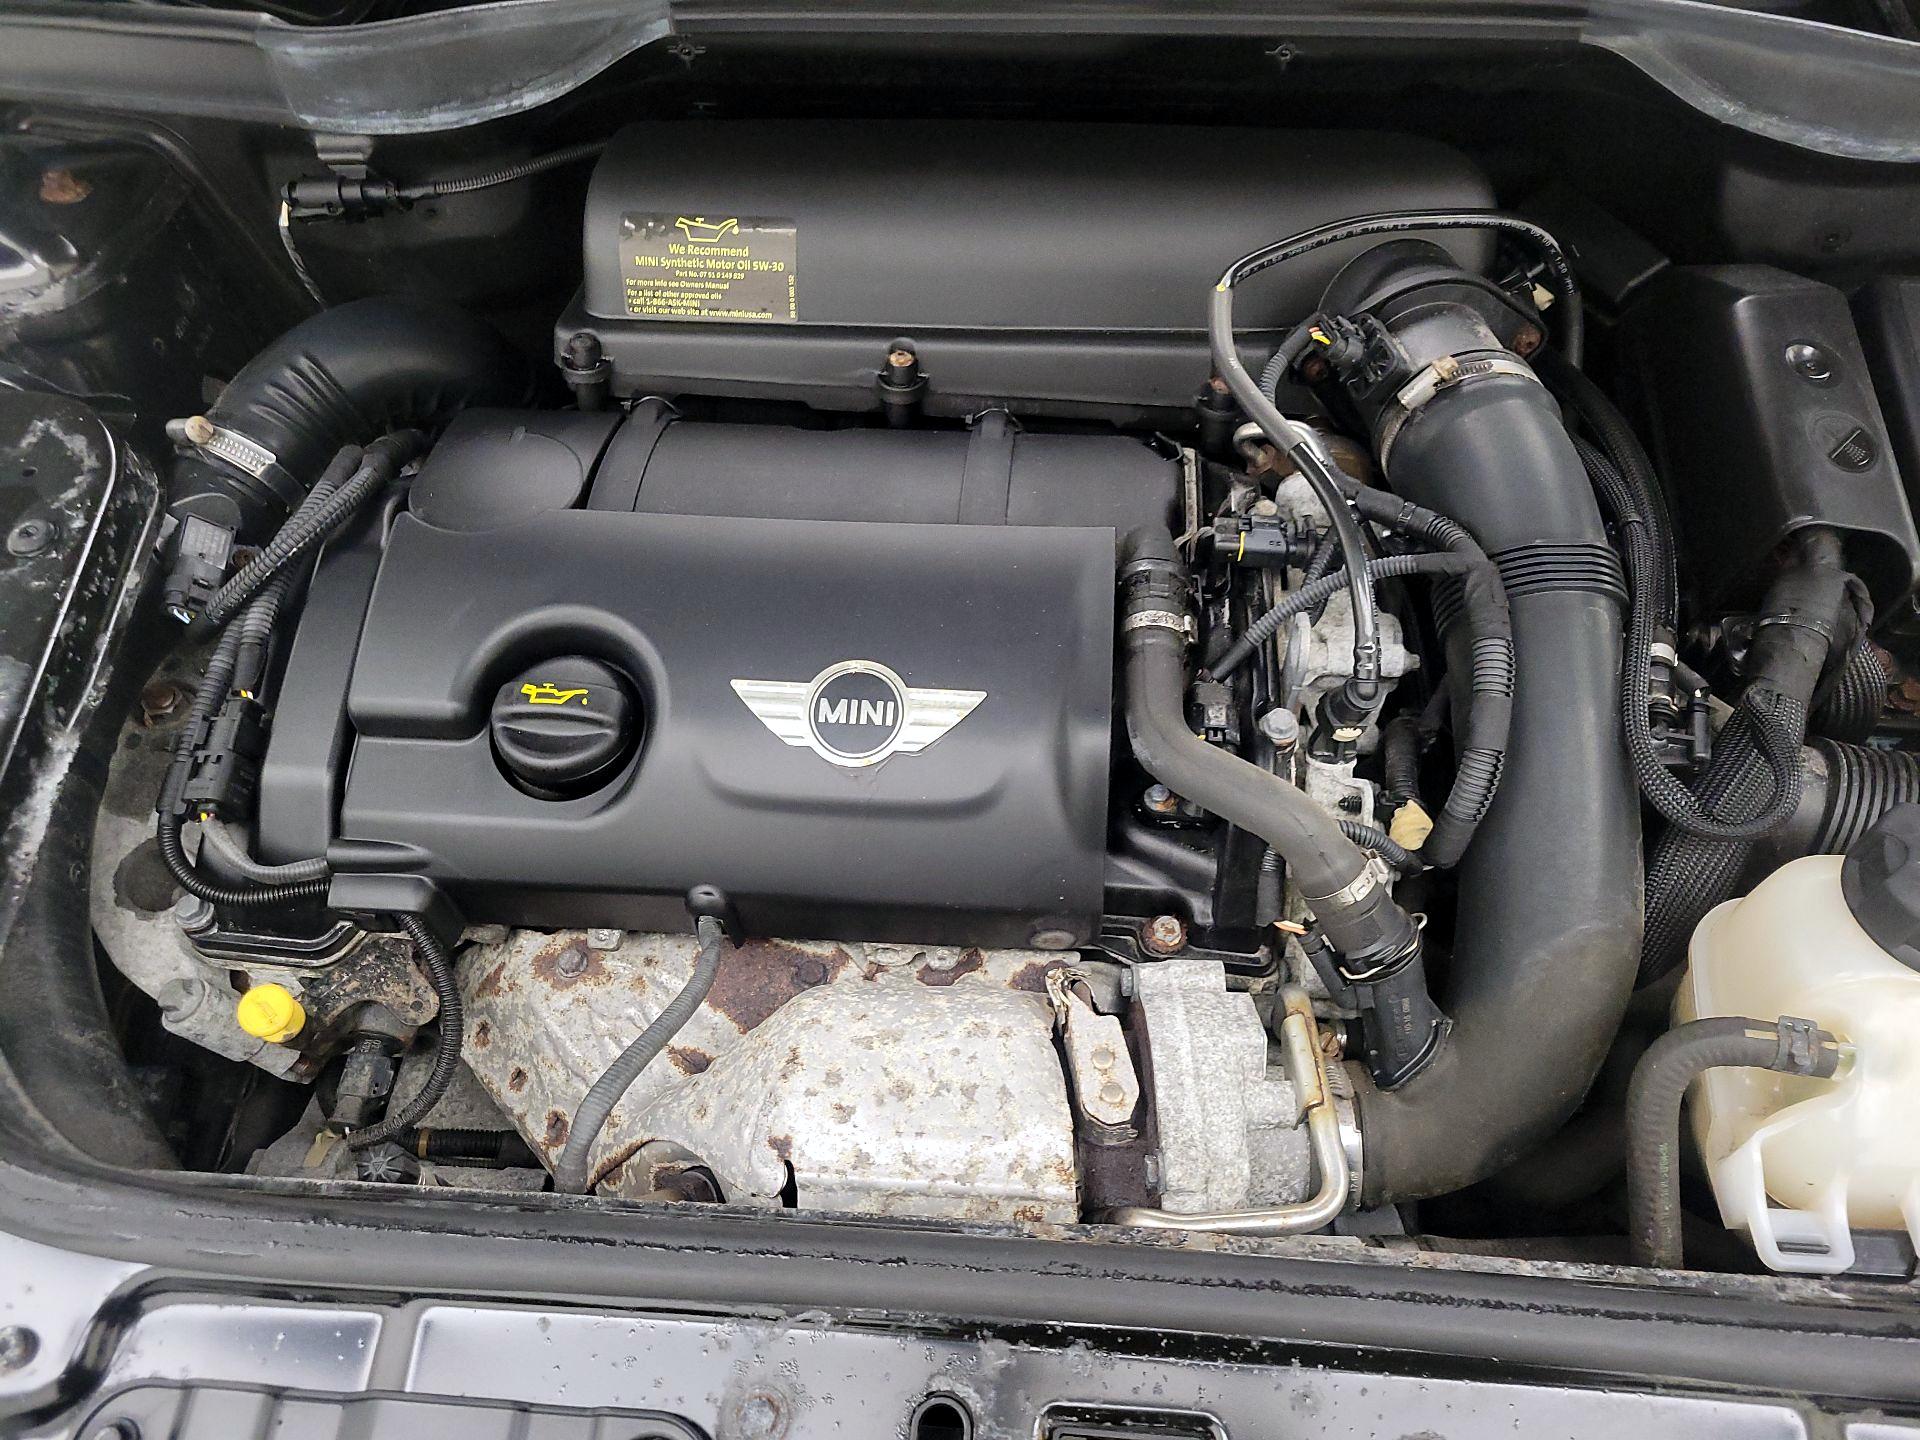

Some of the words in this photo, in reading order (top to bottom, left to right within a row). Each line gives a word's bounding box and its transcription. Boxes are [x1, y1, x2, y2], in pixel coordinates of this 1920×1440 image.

[669, 243, 685, 254] We
[688, 244, 749, 257] Recommend
[635, 256, 659, 267] MINI
[660, 256, 705, 270] Synthetic
[706, 259, 735, 270] Motor
[737, 260, 751, 271] Oil
[752, 261, 785, 272] 5W-30
[689, 270, 699, 278] No.
[626, 278, 636, 286] For
[655, 279, 667, 287] info
[680, 280, 704, 288] Owners
[705, 281, 729, 290] Manual
[633, 297, 645, 305] call
[644, 289, 653, 297] list
[654, 289, 662, 297] of
[662, 290, 680, 298] other
[680, 291, 710, 300] approved
[710, 292, 722, 300] oils
[642, 306, 657, 314] visit
[671, 307, 686, 315] web
[687, 307, 700, 316] site
[700, 308, 708, 316] at
[709, 309, 773, 320] www.miniusa.com
[817, 697, 895, 727] MINI
